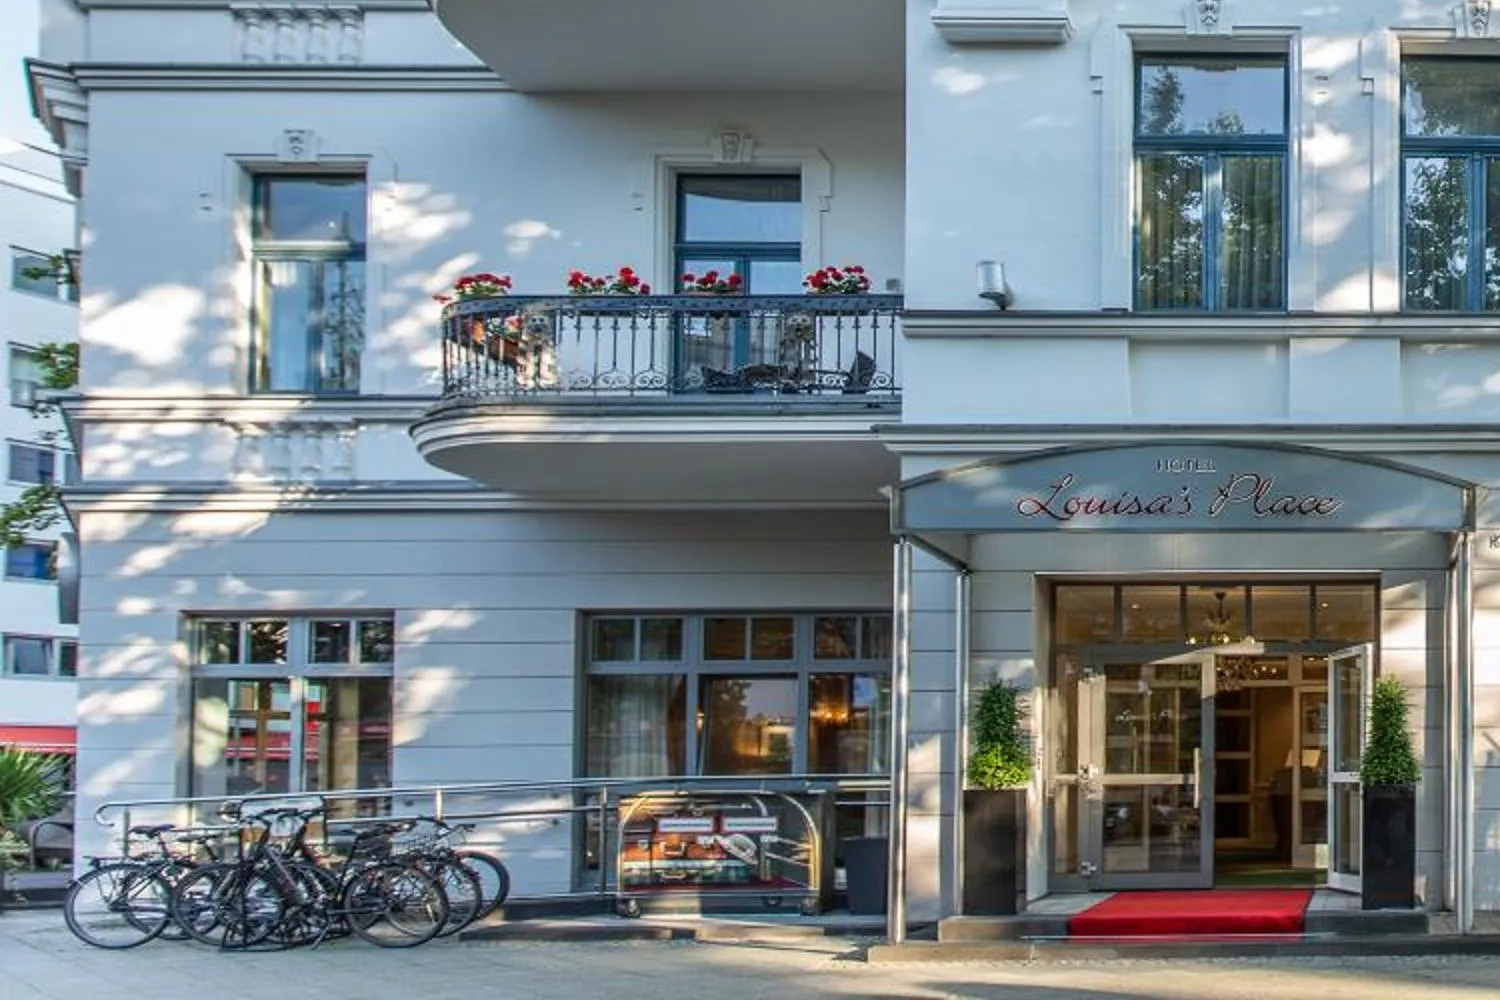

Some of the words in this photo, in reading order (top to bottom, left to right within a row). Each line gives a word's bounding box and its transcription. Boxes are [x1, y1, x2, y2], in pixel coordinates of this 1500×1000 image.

[1156, 458, 1216, 473] HOTEL
[1017, 473, 1192, 520] Louisa's
[1208, 473, 1342, 517] Place
